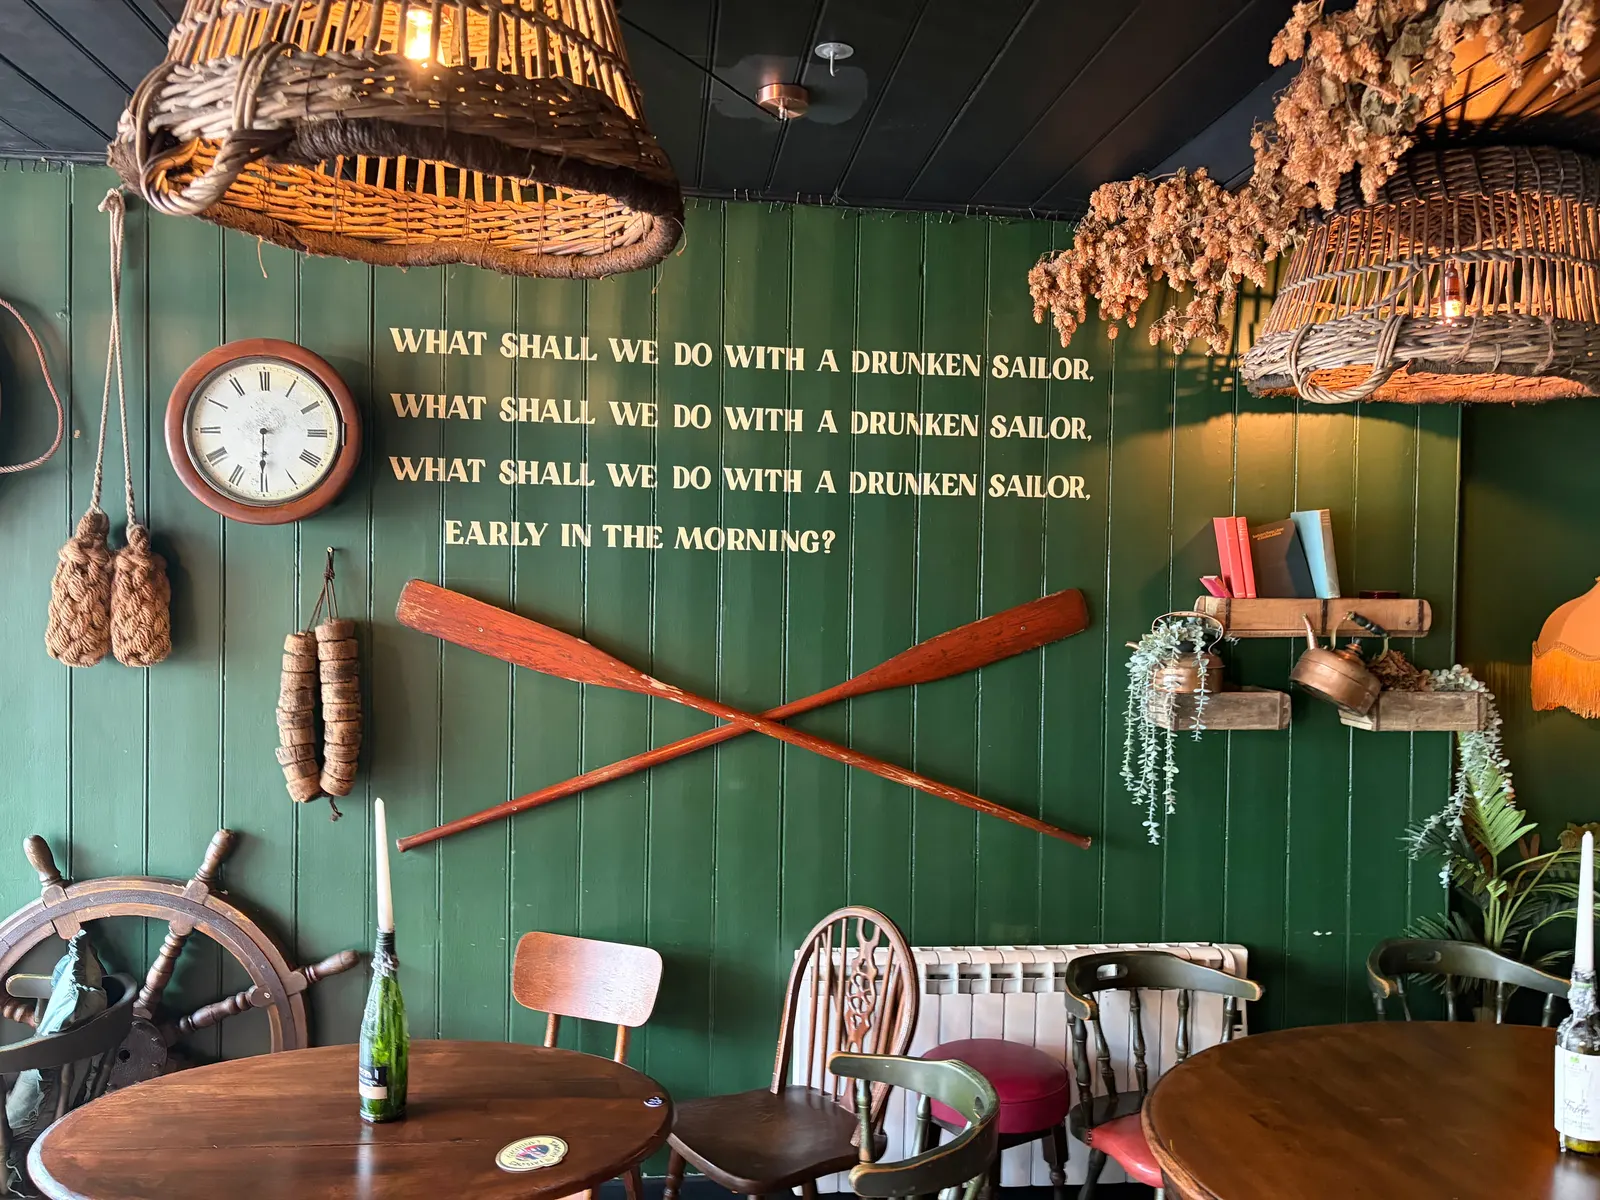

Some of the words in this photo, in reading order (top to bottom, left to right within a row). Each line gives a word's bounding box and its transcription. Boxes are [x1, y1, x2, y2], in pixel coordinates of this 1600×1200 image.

[389, 327, 487, 356] WHAT
[500, 332, 598, 361] SHALL
[608, 337, 659, 365] WE
[674, 342, 713, 367] DO
[723, 344, 805, 371] WITH
[817, 349, 840, 373] A
[851, 350, 982, 378] DRUNKEN
[991, 354, 1095, 383] SAILOR,
[390, 393, 487, 421] WHAT
[499, 396, 596, 425] SHALL
[608, 400, 659, 428] WE
[673, 404, 712, 430] DO
[723, 406, 804, 433] WITH
[817, 409, 838, 434] A
[850, 411, 979, 438] DRUNKEN
[989, 414, 1092, 442] SAILOR,
[389, 456, 486, 483] WHAT
[498, 459, 595, 487] SHALL
[606, 463, 658, 489] WE
[673, 465, 712, 491] DO
[723, 468, 803, 494] WITH
[815, 470, 837, 495] A
[850, 471, 978, 497] DRUNKEN
[988, 474, 1091, 501] SAILOR,
[444, 520, 549, 547] EARLY
[561, 523, 592, 549] IN
[602, 524, 663, 550] THE
[674, 526, 836, 555] MORNING?
